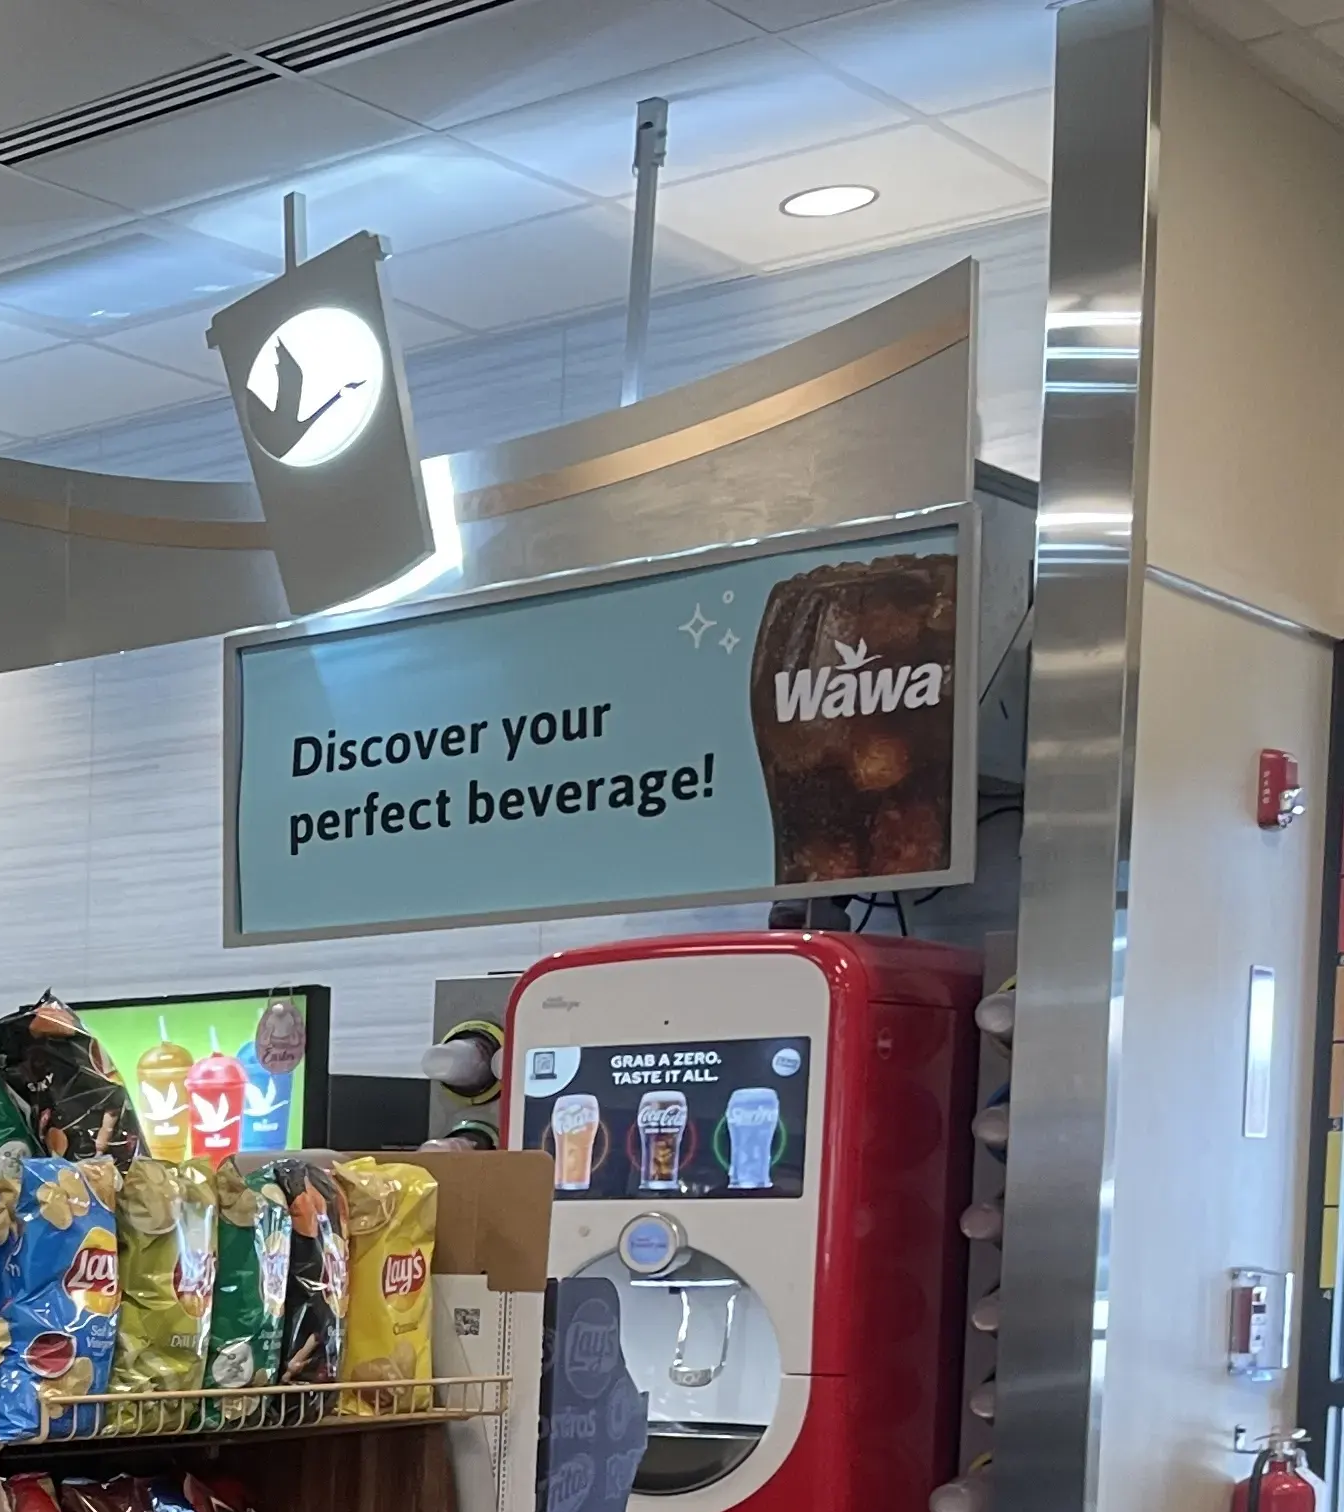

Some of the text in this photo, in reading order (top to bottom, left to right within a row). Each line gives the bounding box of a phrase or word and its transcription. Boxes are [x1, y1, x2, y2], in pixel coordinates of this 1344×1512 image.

[774, 658, 943, 725] Wawa
[292, 700, 612, 778] Discover your
[289, 752, 716, 856] perfect beverage!
[611, 1051, 723, 1069] GRAB A ZERO.
[612, 1067, 719, 1086] TASTE IT ALL.
[384, 1253, 424, 1295] Lay's
